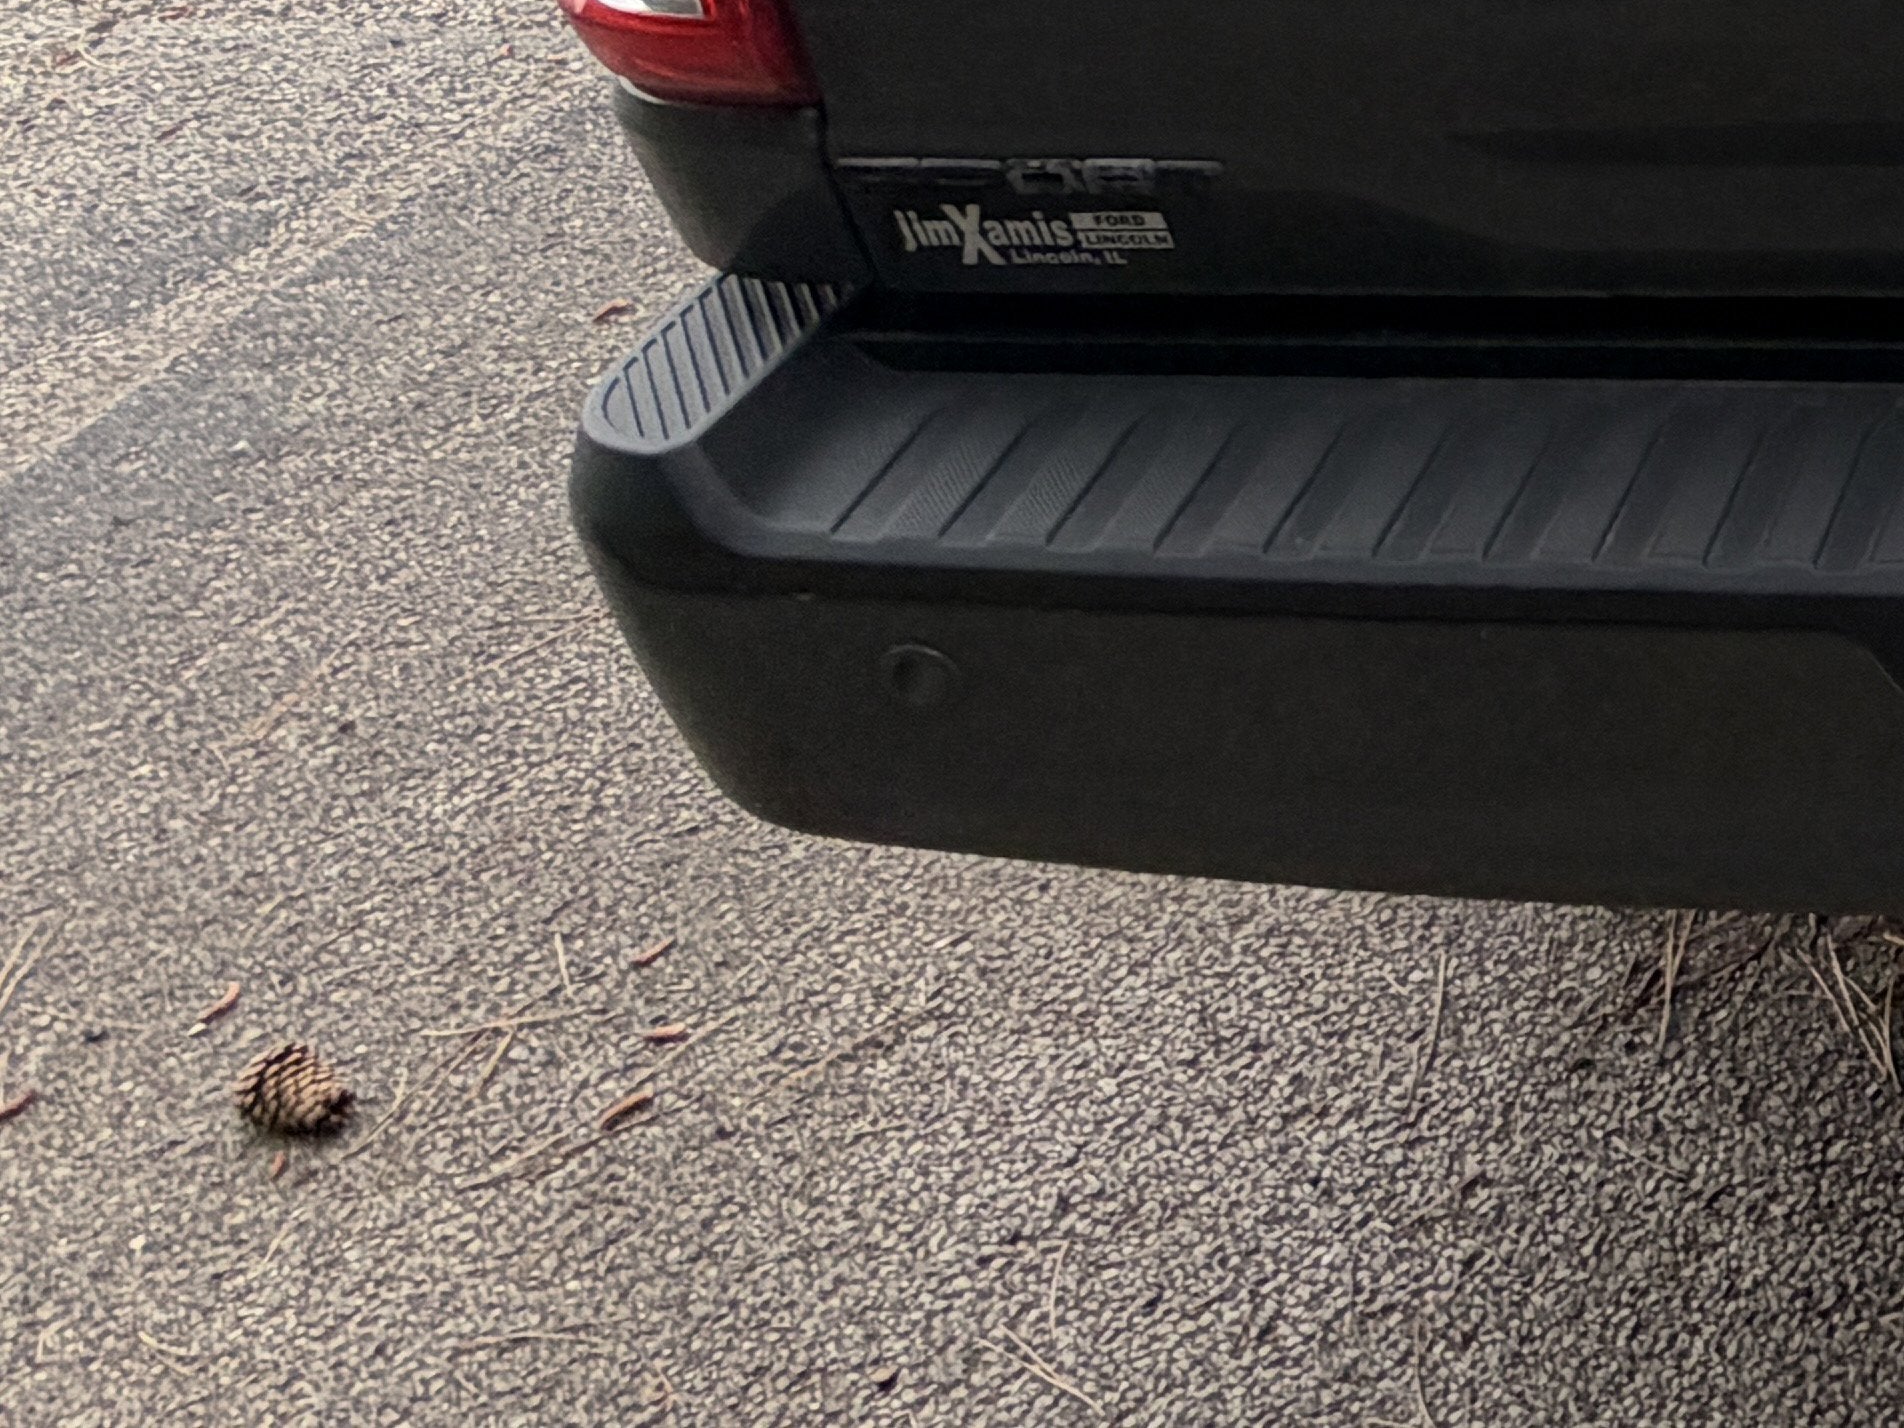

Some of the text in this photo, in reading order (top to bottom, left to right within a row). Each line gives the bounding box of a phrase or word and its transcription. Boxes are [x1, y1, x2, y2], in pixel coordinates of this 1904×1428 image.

[1092, 214, 1148, 228] FORD
[1084, 233, 1172, 249] LINCOLN
[1010, 250, 1129, 266] Lincoln, IL
